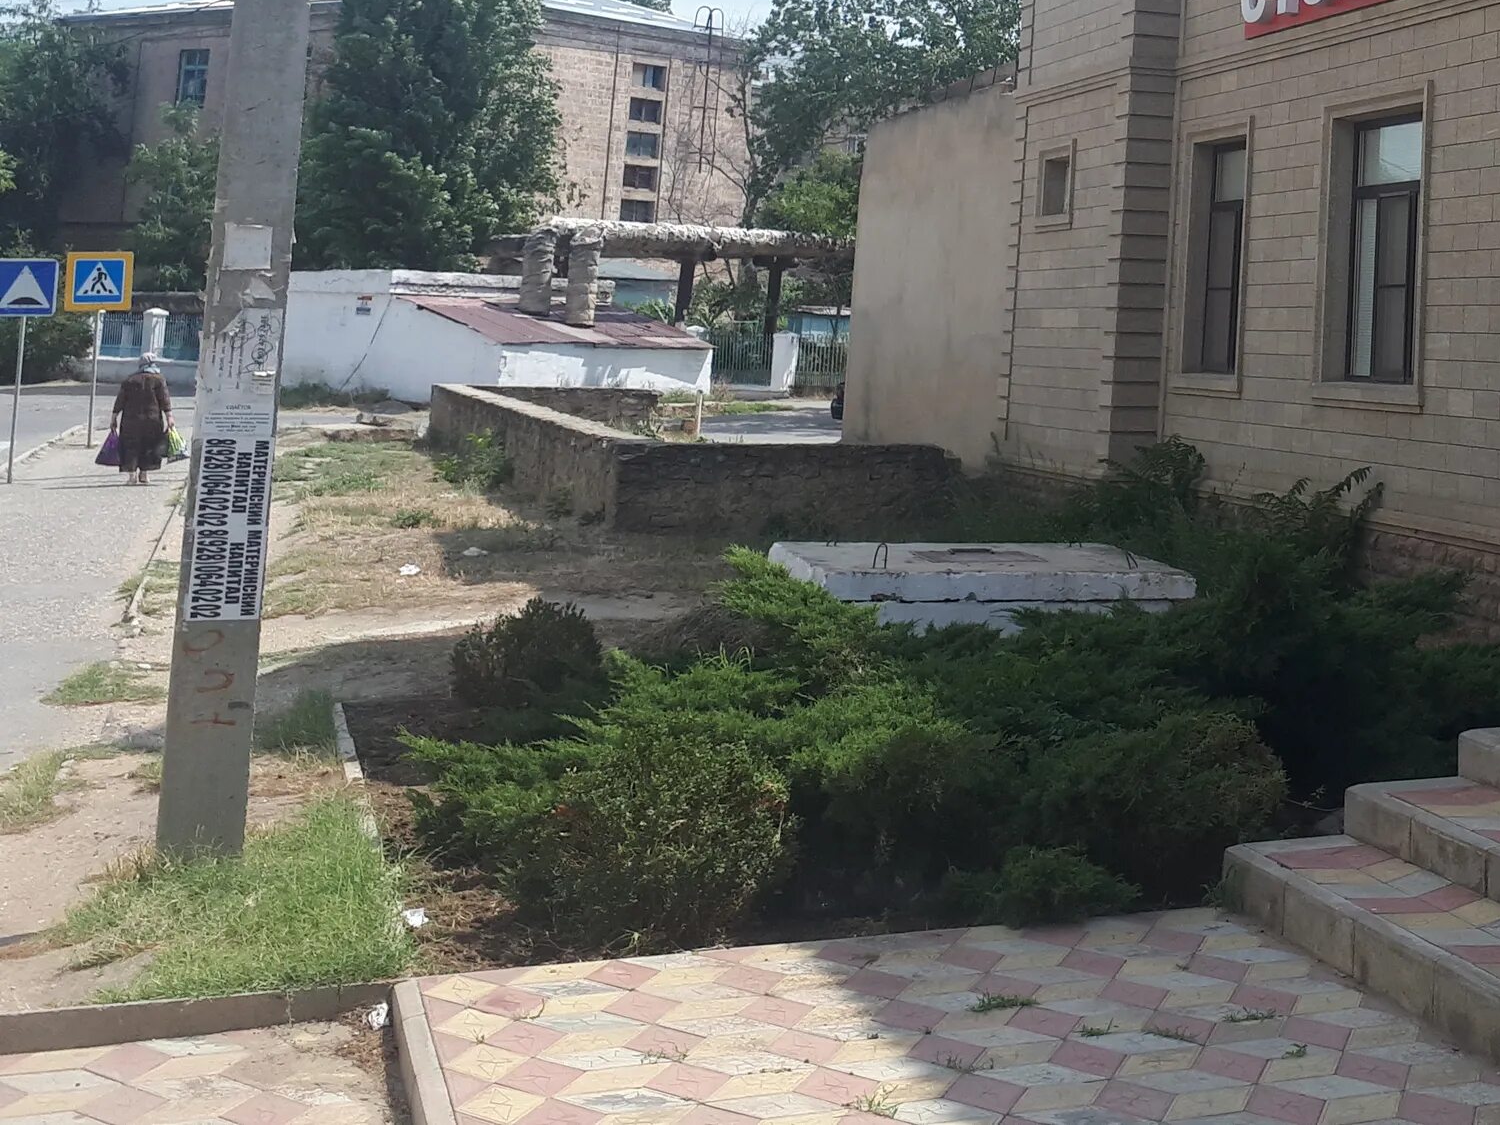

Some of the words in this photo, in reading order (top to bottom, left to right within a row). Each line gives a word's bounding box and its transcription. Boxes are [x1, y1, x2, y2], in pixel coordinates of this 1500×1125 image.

[231, 452, 252, 514] КАПИТАЛ
[247, 440, 270, 526] МАТЕРИНСКИЙ
[224, 542, 245, 604] КАПИТАЛ
[240, 530, 263, 616] МАТЕРИНСКИЙ
